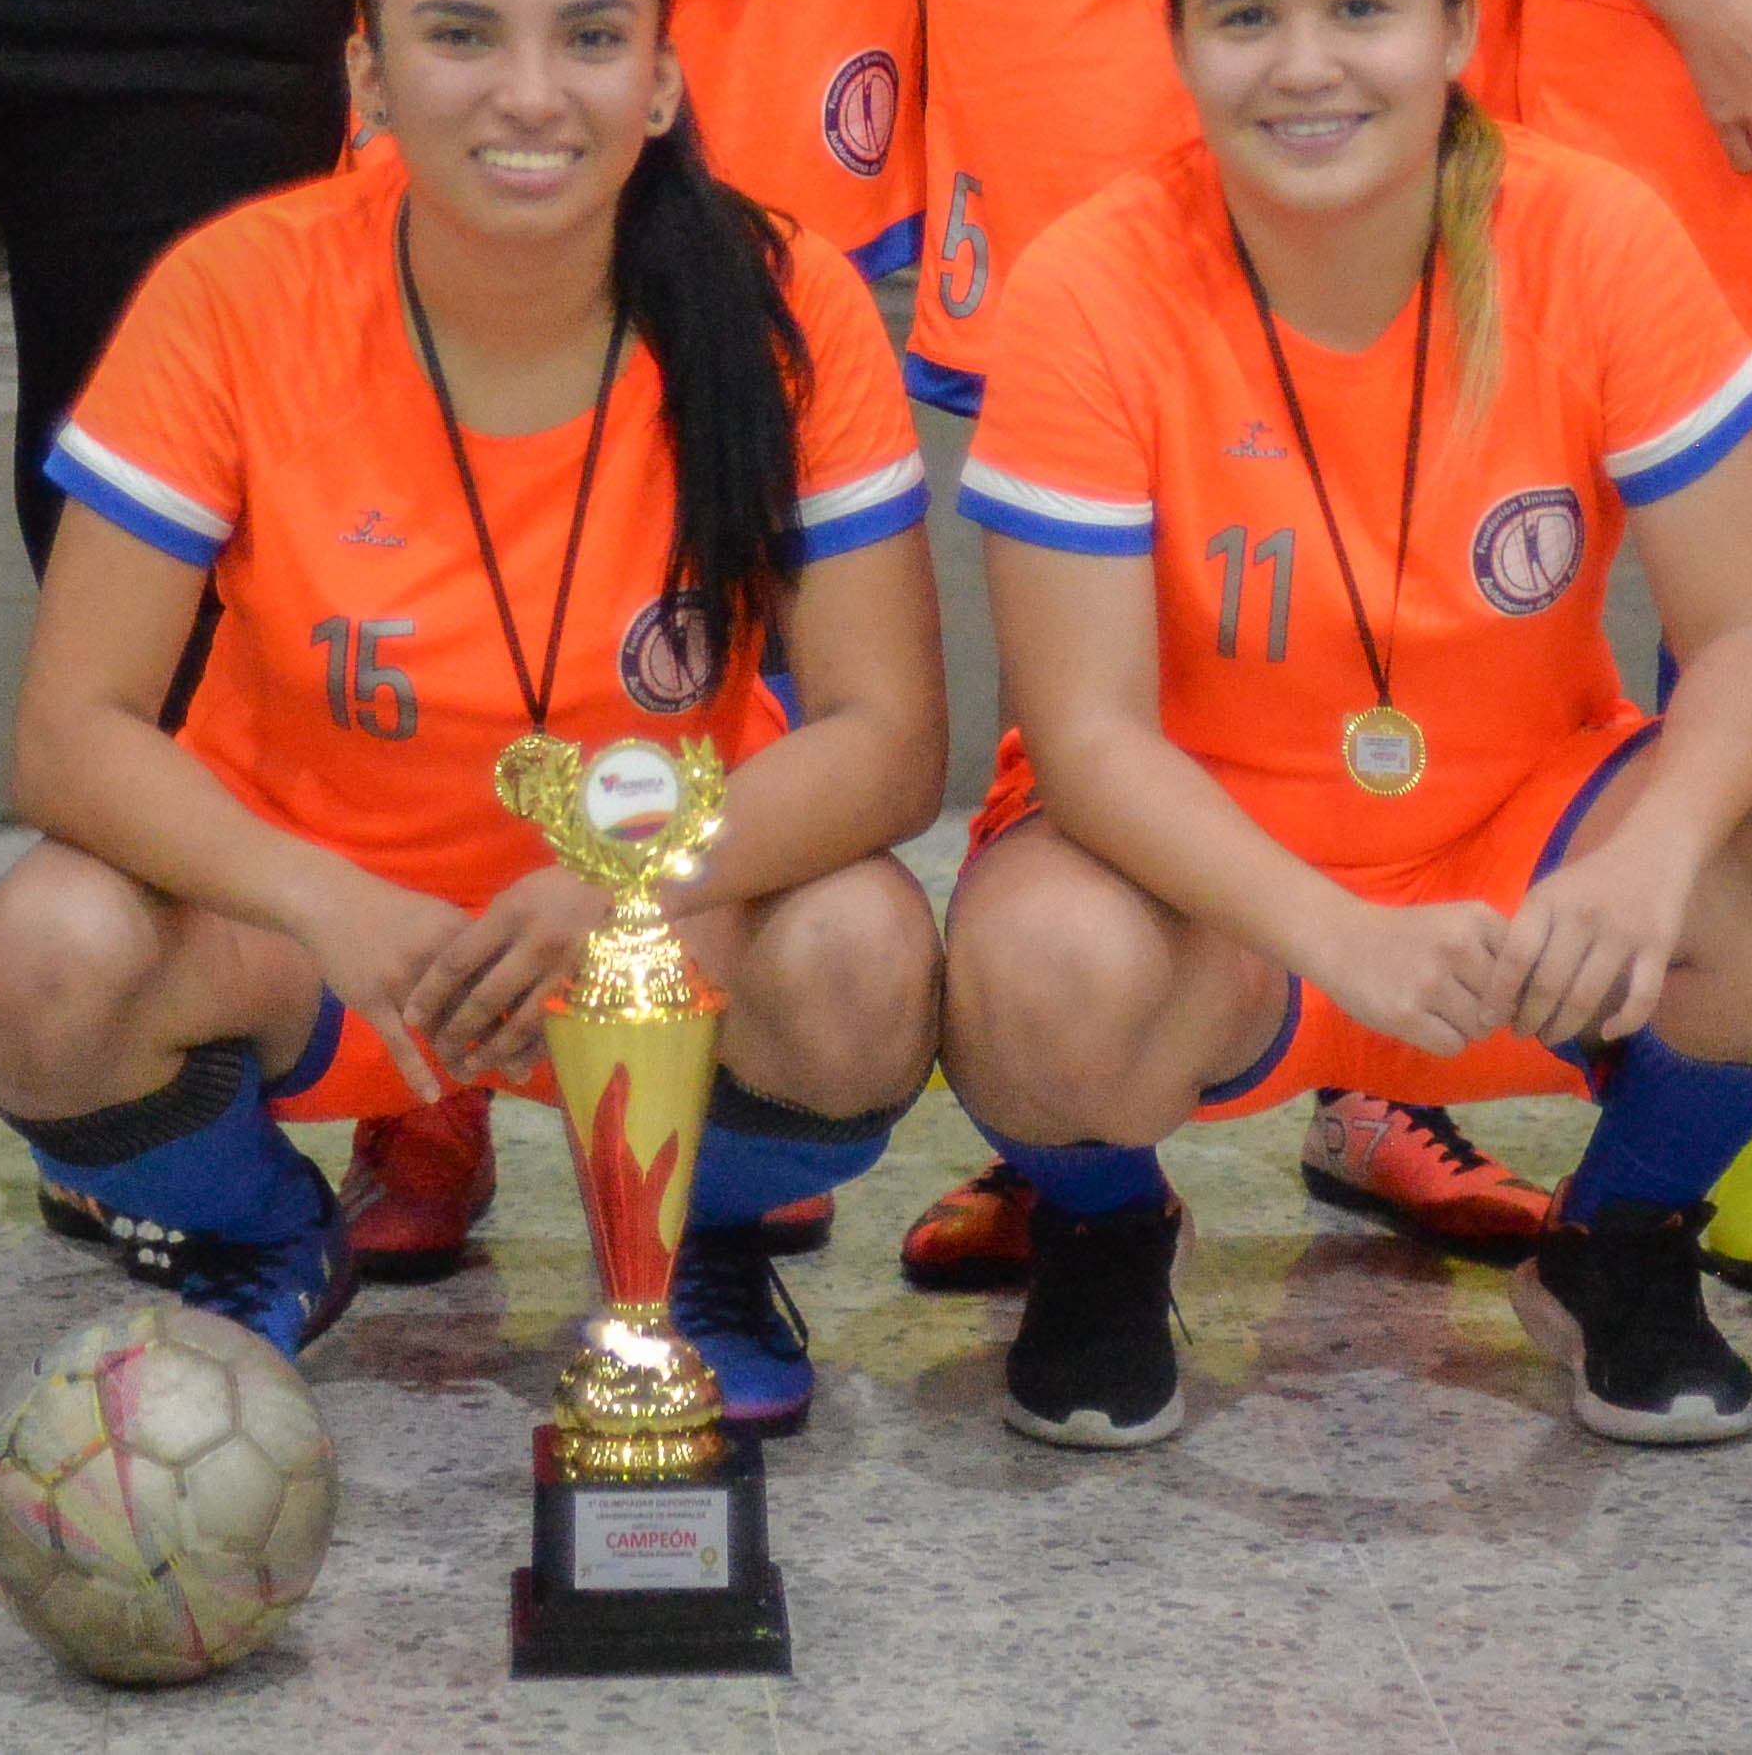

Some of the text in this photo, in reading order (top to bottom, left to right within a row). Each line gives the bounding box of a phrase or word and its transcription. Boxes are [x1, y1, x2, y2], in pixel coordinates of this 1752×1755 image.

[940, 171, 990, 319] 5
[1206, 524, 1295, 663] 11
[310, 614, 418, 743] 15
[606, 1527, 698, 1549] CAMPEÓN
